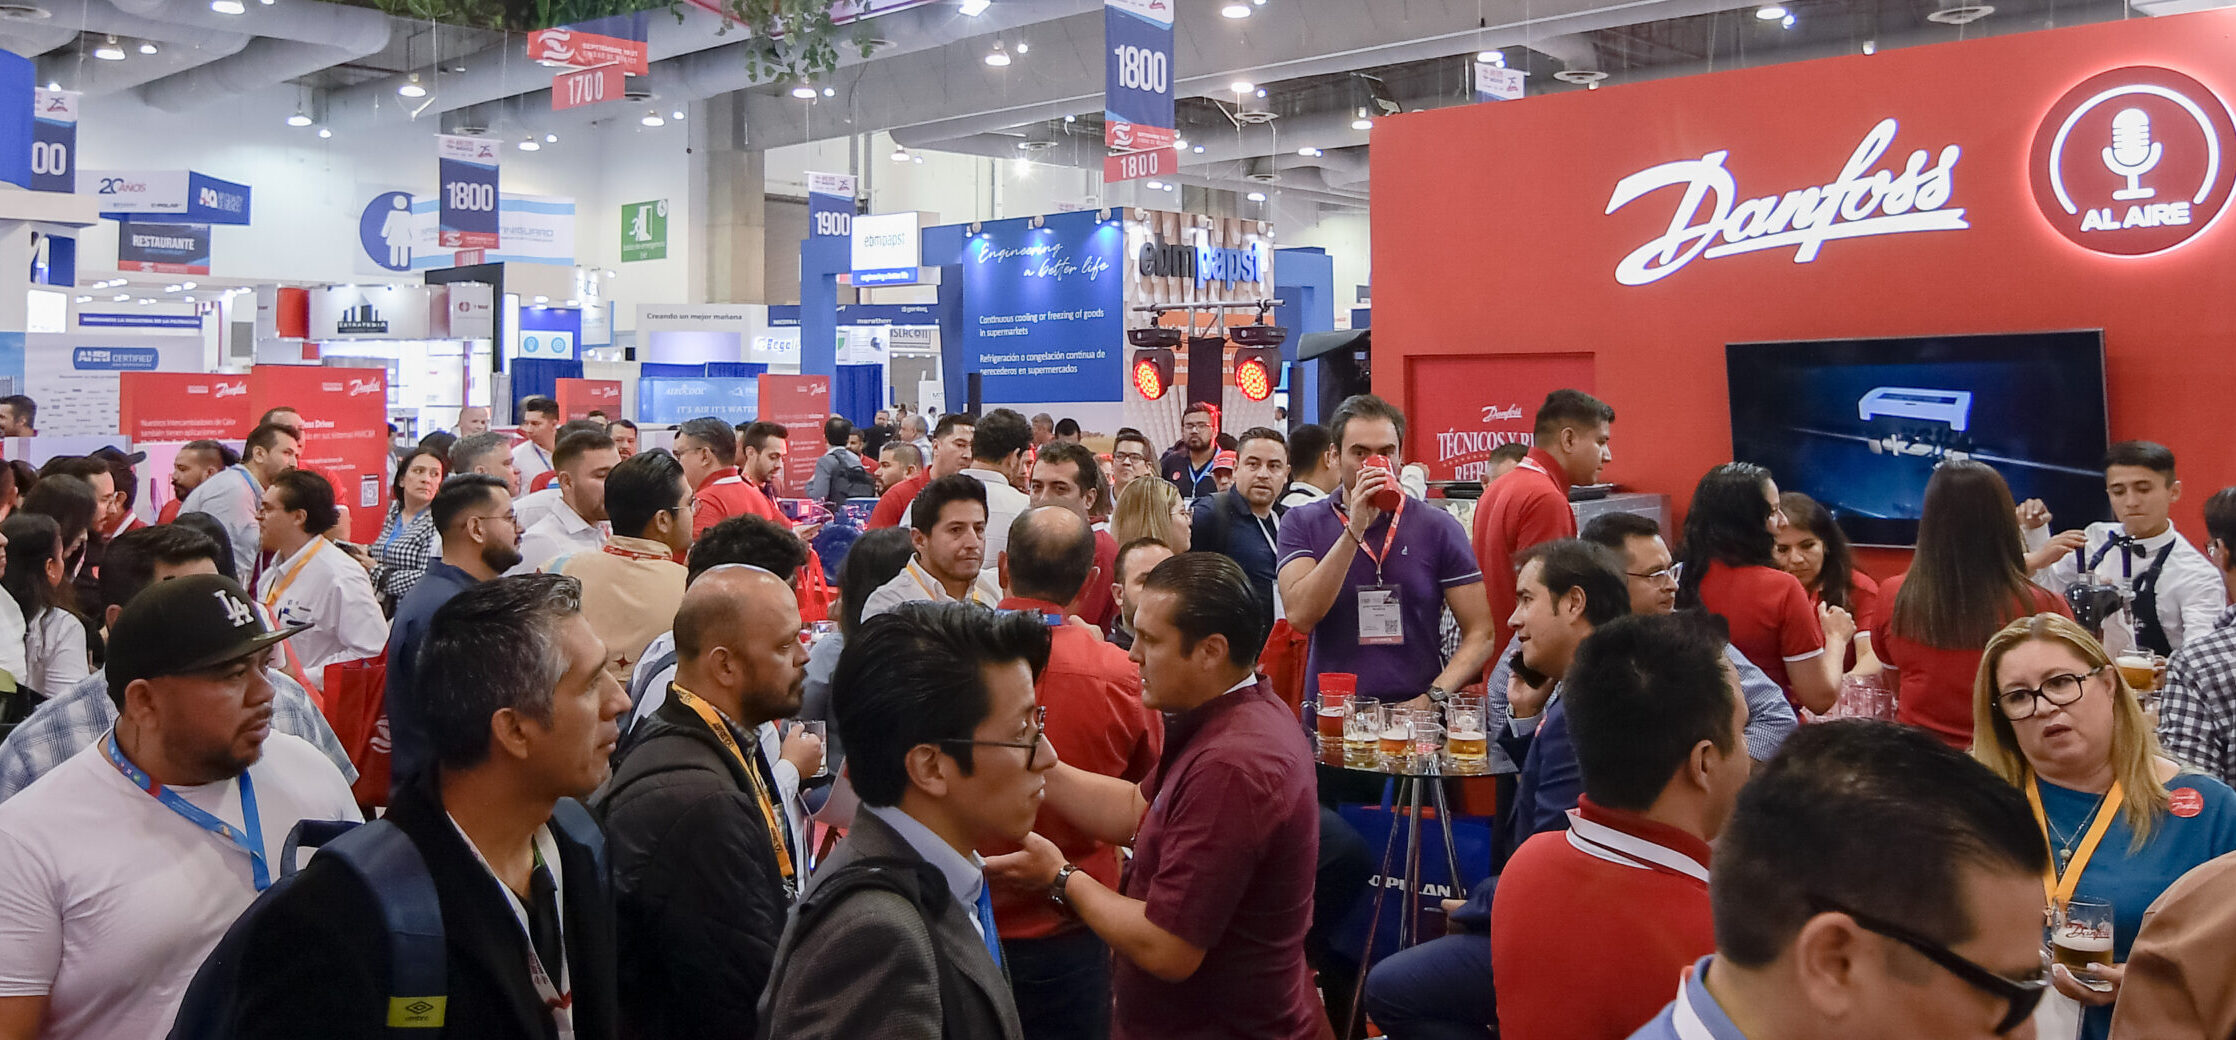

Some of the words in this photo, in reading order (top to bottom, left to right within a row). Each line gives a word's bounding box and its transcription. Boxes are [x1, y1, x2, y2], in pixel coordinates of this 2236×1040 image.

[1114, 44, 1167, 94] 1800
[567, 71, 604, 105] 1700
[1120, 152, 1159, 179] 1800
[446, 181, 494, 212] 1800
[1605, 118, 1970, 286] Danfoss
[815, 211, 850, 236] 1900
[2081, 208, 2121, 231] AL
[2123, 200, 2192, 228] AIRE
[132, 234, 195, 251] RESTAURANTE
[978, 242, 1064, 263] Engineering
[1024, 269, 1035, 277] a
[1037, 257, 1077, 281] better
[1081, 256, 1109, 281] life
[1139, 233, 1263, 291] ebmpapst
[690, 313, 712, 322] mejor
[979, 315, 1014, 325] Continuous
[1015, 313, 1038, 323] cooling
[1047, 310, 1074, 321] freezing
[1075, 309, 1083, 319] of
[1083, 308, 1104, 319] goods
[987, 327, 1029, 338] supermarkets
[112, 354, 154, 363] CERTIFIED
[979, 353, 1020, 365] Refrigeración
[1026, 351, 1065, 363] congelación
[1065, 351, 1095, 360] continua
[1096, 349, 1106, 358] de
[1018, 367, 1027, 375] en
[1028, 365, 1078, 377] supermercados
[215, 381, 248, 398] Danfoss
[350, 377, 381, 396] Danfoss
[1482, 403, 1522, 423] Danfoss
[1437, 427, 1505, 462] TÉCNICOS
[214, 589, 254, 628] LA
